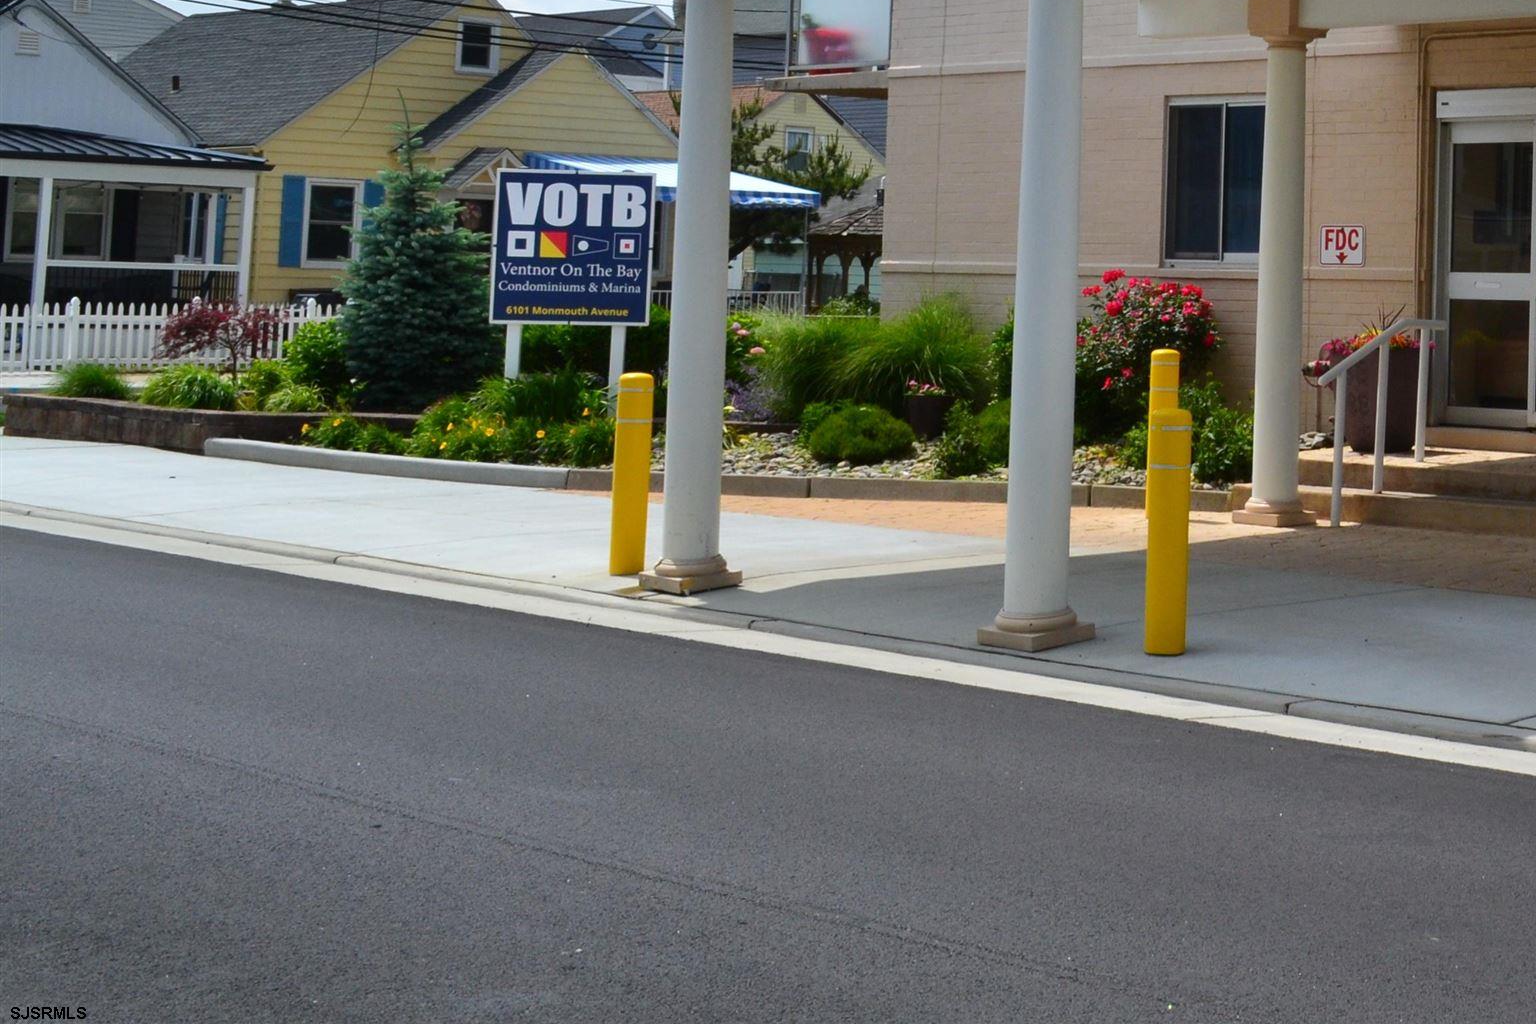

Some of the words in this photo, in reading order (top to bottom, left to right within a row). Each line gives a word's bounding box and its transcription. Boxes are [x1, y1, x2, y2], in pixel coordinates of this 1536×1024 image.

[506, 182, 647, 227] VOTB
[1325, 229, 1359, 251] FDC
[500, 262, 557, 276] Ventnor
[560, 264, 583, 277] On
[587, 264, 613, 277] The
[617, 265, 642, 281] Bay
[499, 280, 586, 293] Condominiums
[589, 282, 599, 293] &
[601, 282, 641, 294] Marina
[506, 305, 530, 315] 6101
[532, 306, 588, 317] Monmouth
[591, 307, 629, 317] Avenue
